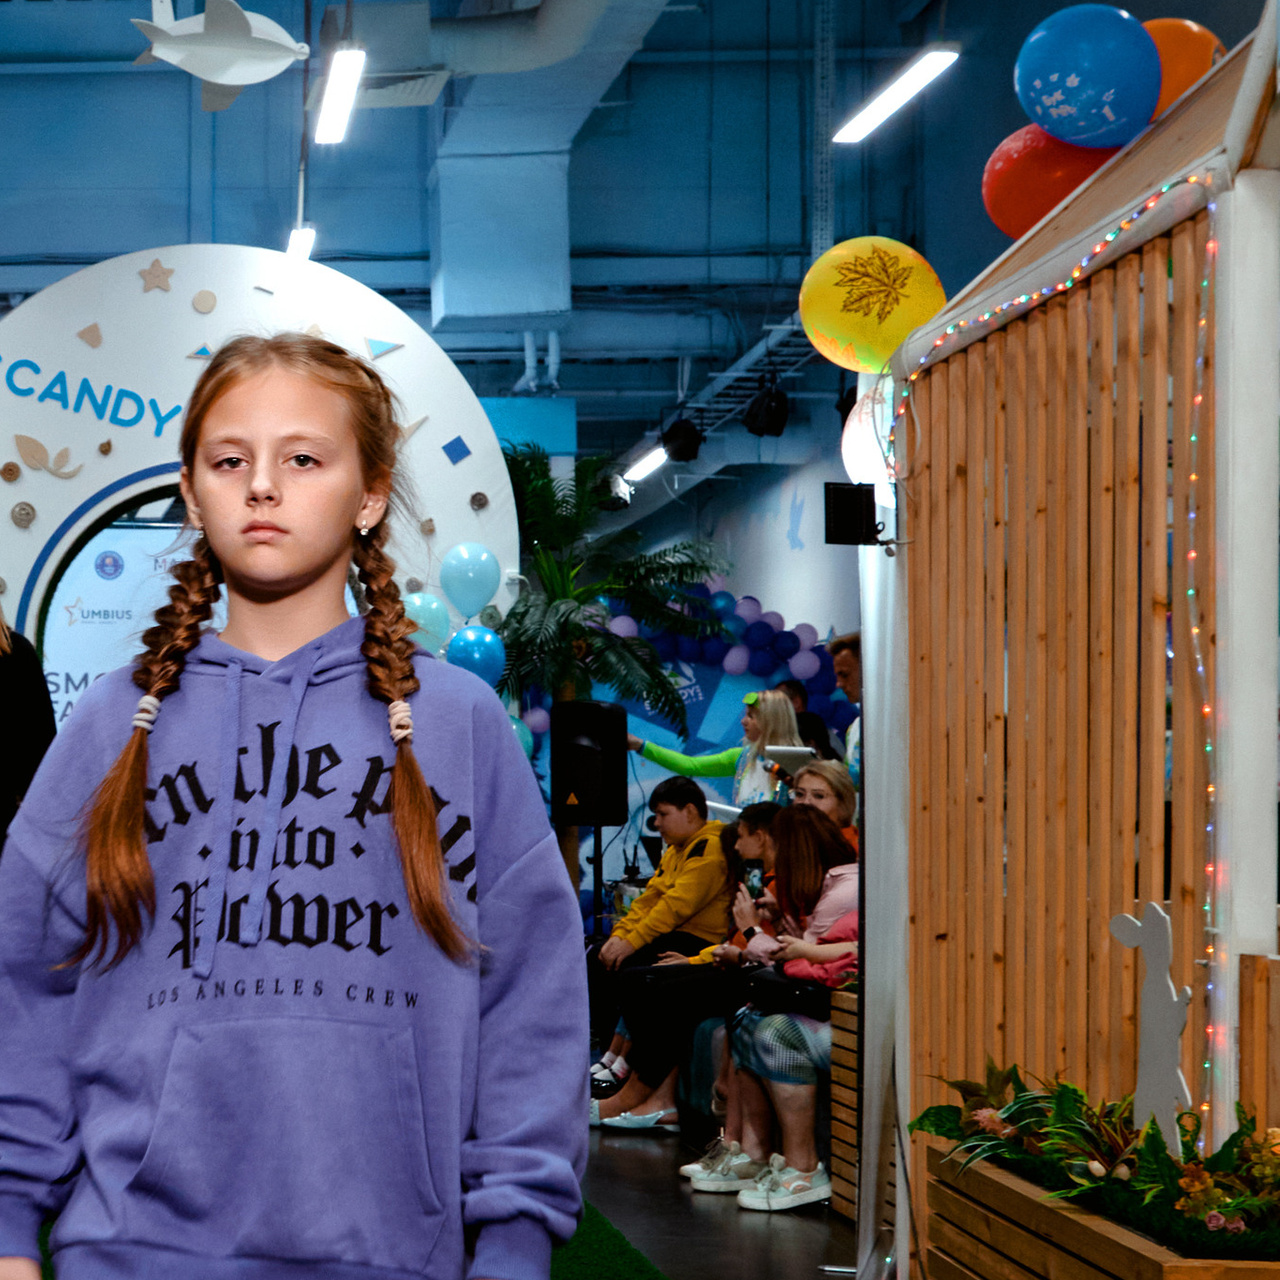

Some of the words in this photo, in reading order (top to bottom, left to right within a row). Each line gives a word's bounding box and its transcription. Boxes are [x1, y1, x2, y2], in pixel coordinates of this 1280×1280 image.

[167, 876, 401, 970] Power
[147, 985, 180, 1010] LOS
[195, 978, 325, 1001] ANGELES
[346, 983, 419, 1009] CREW
